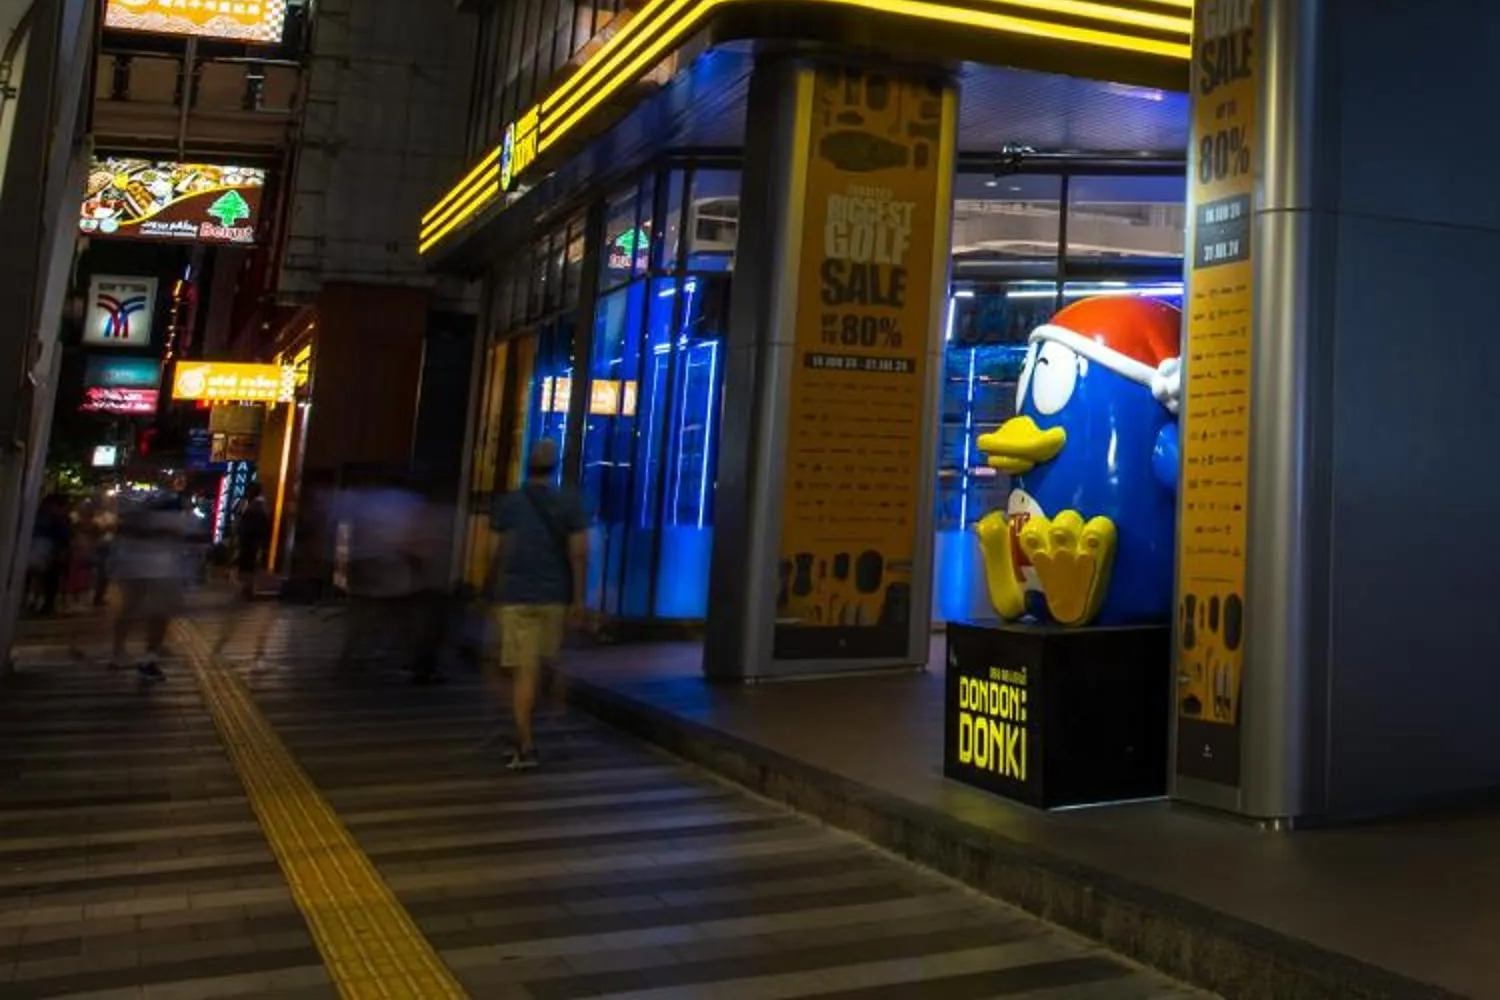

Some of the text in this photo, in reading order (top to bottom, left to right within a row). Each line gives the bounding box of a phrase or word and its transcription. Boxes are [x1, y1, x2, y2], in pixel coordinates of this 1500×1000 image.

[1200, 125, 1249, 184] 80%
[824, 222, 911, 264] GOLF
[820, 258, 907, 309] SALE
[841, 313, 902, 347] 80%
[959, 712, 1027, 781] DONKI
